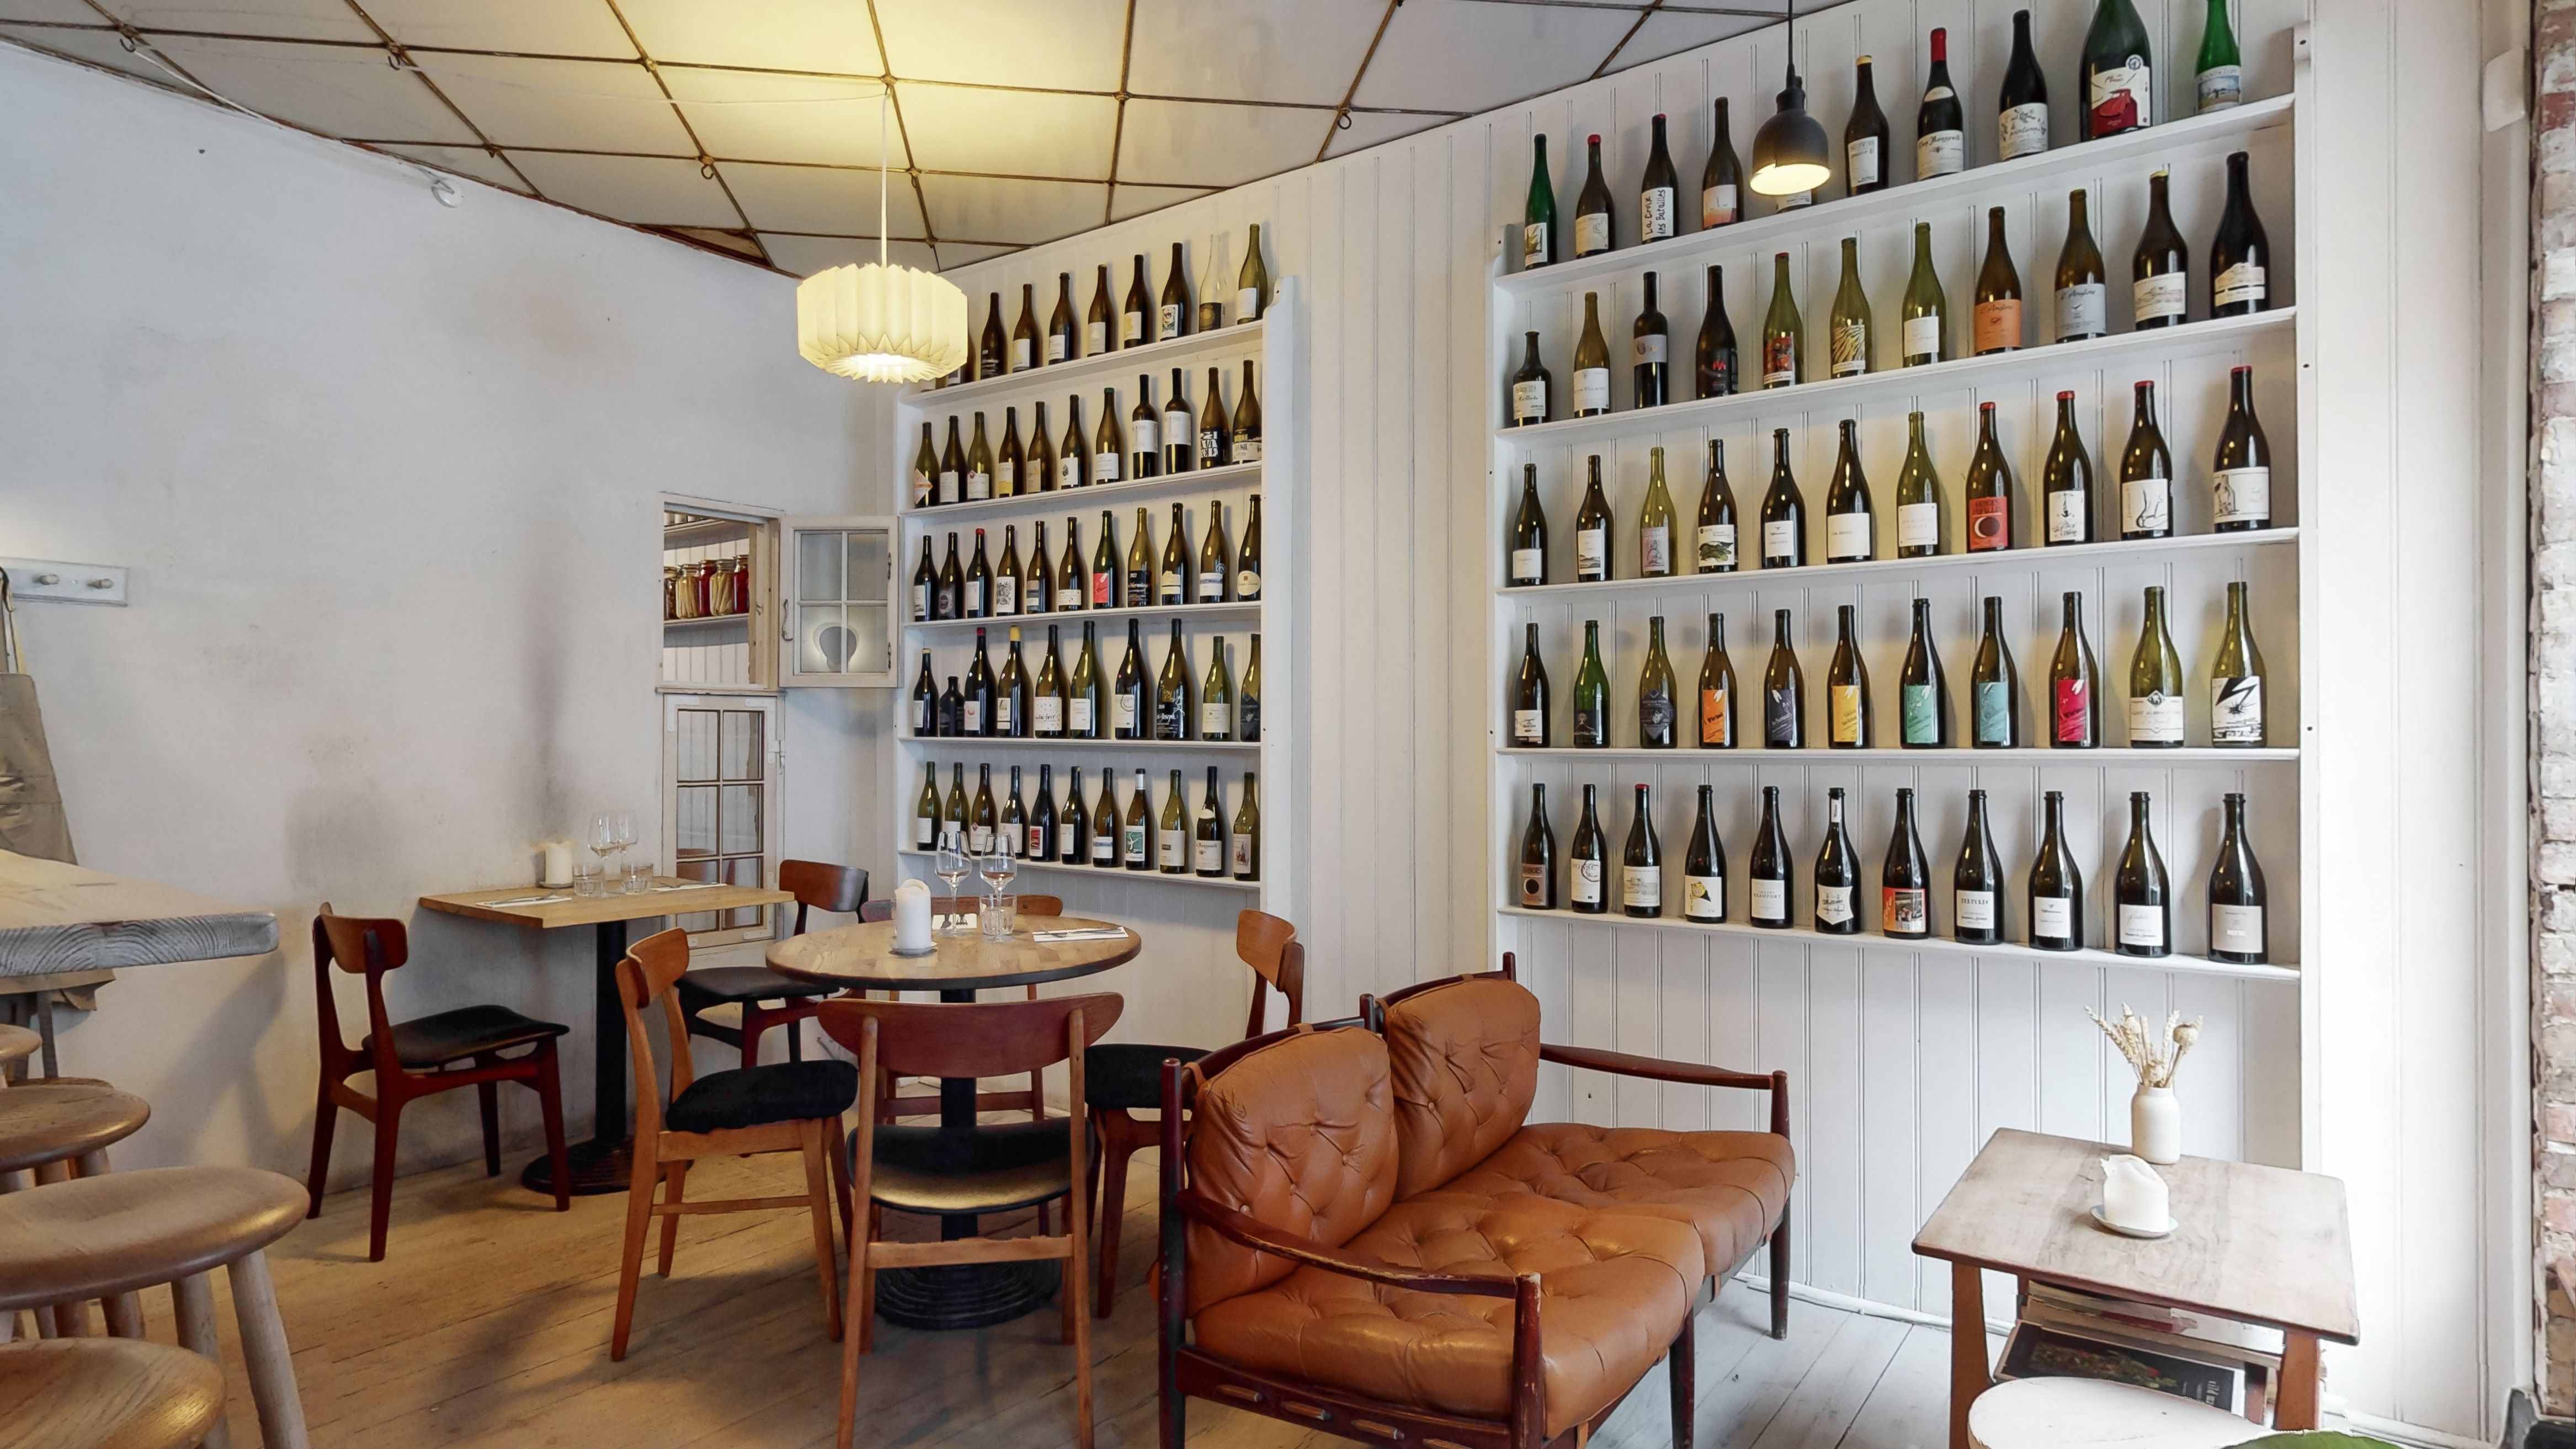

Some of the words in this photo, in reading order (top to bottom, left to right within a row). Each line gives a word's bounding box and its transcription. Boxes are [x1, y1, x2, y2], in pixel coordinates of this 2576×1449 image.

[1644, 196, 1652, 219] Croix
[1656, 189, 1665, 221] Batailles
[1644, 221, 1653, 235] La
